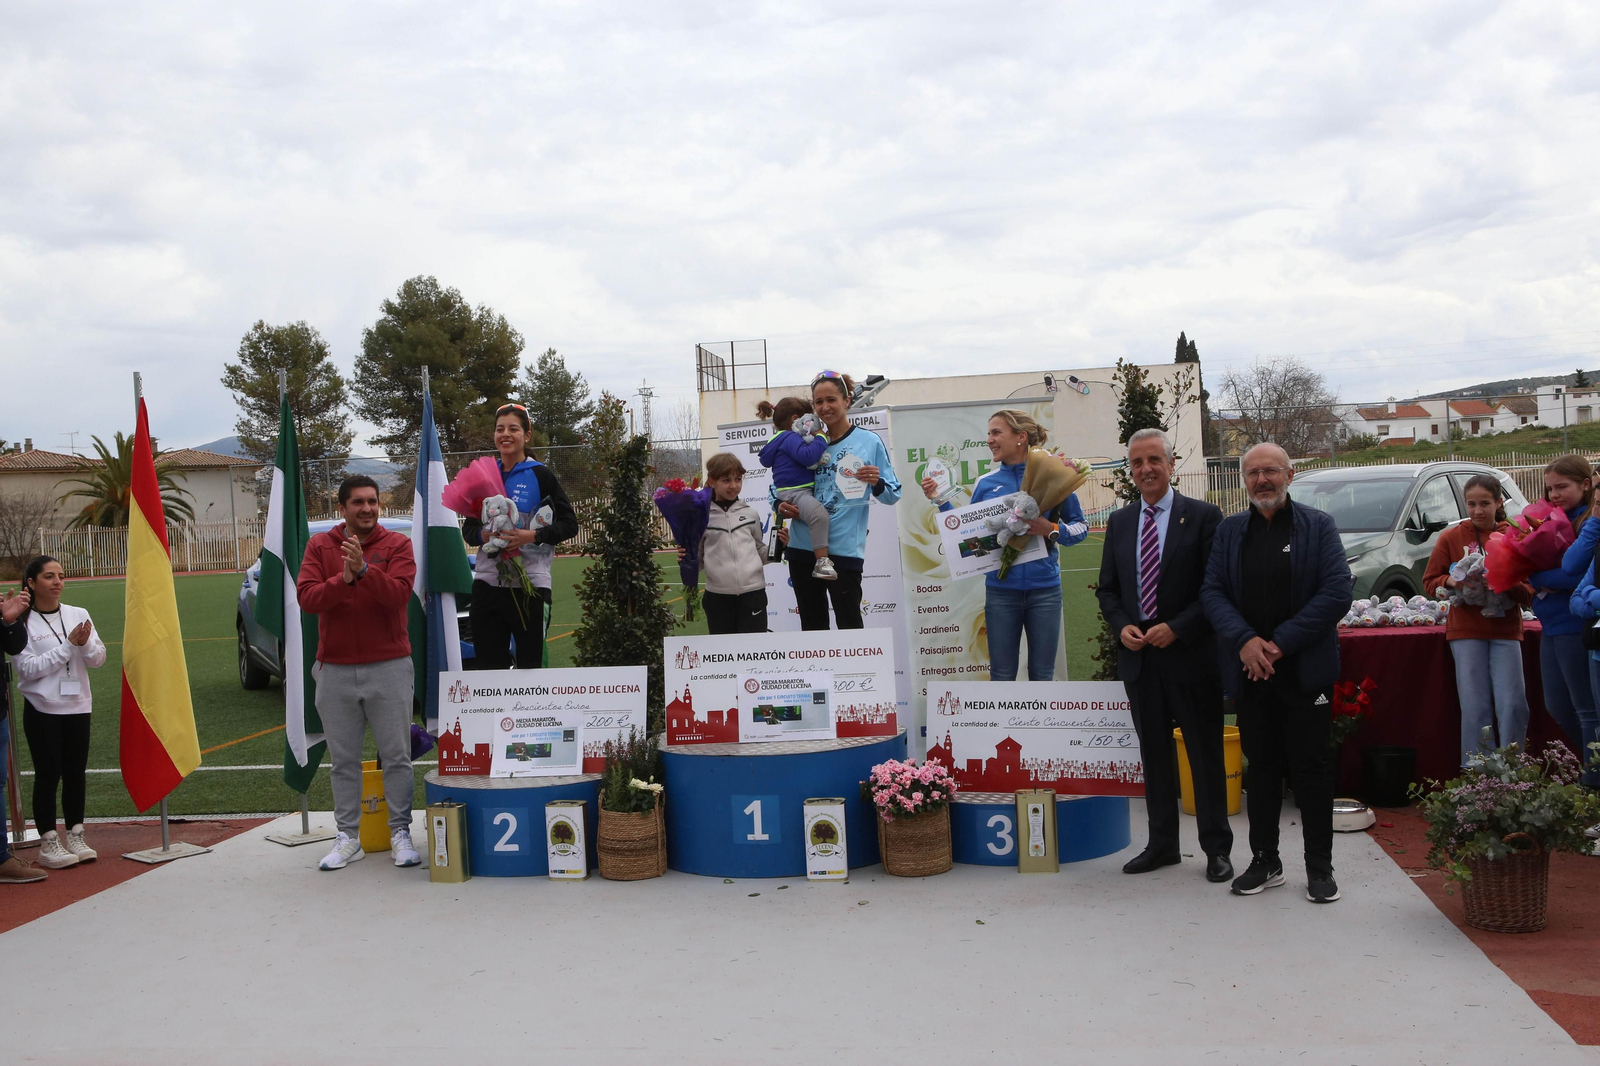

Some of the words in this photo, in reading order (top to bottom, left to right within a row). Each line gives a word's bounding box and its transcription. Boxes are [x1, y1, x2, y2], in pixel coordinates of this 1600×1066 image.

[725, 428, 767, 441] SERVICIO
[907, 447, 928, 463] EL
[960, 508, 979, 519] MEDIA
[978, 502, 1004, 514] MARATÓN
[961, 514, 984, 524] CIUDAD
[916, 584, 942, 594] Bodas
[917, 604, 950, 614] Eventos
[919, 624, 960, 635] Jardinería
[702, 653, 735, 663] MEDIA
[736, 649, 786, 662] MARATÓN
[788, 649, 826, 660] CIUDAD
[828, 649, 842, 658] DE
[844, 647, 883, 657] LUCENA
[920, 644, 963, 657] Paisajismo
[921, 666, 956, 678] Entregas
[473, 688, 502, 697] MEDIA
[504, 685, 549, 696] MARATÓN
[551, 686, 587, 695] CIUDAD
[589, 685, 601, 694] DE
[603, 684, 641, 694] LUCENA
[859, 677, 873, 691] €
[512, 701, 562, 711] Doscientos
[564, 700, 590, 710] Euros
[964, 701, 995, 710] MEDIA
[998, 699, 1047, 710] MARATÓN
[1050, 701, 1088, 711] CIUDAD
[1091, 701, 1104, 711] DE
[586, 715, 613, 728] 200
[617, 714, 630, 728] €
[1008, 717, 1041, 727] Ciento
[1043, 717, 1097, 727] Cincuenta
[1097, 717, 1127, 727] Euros
[1088, 734, 1113, 747] 150
[1117, 733, 1132, 747] €
[743, 799, 769, 841] 1
[493, 812, 520, 852] 2
[986, 814, 1014, 856] 3
